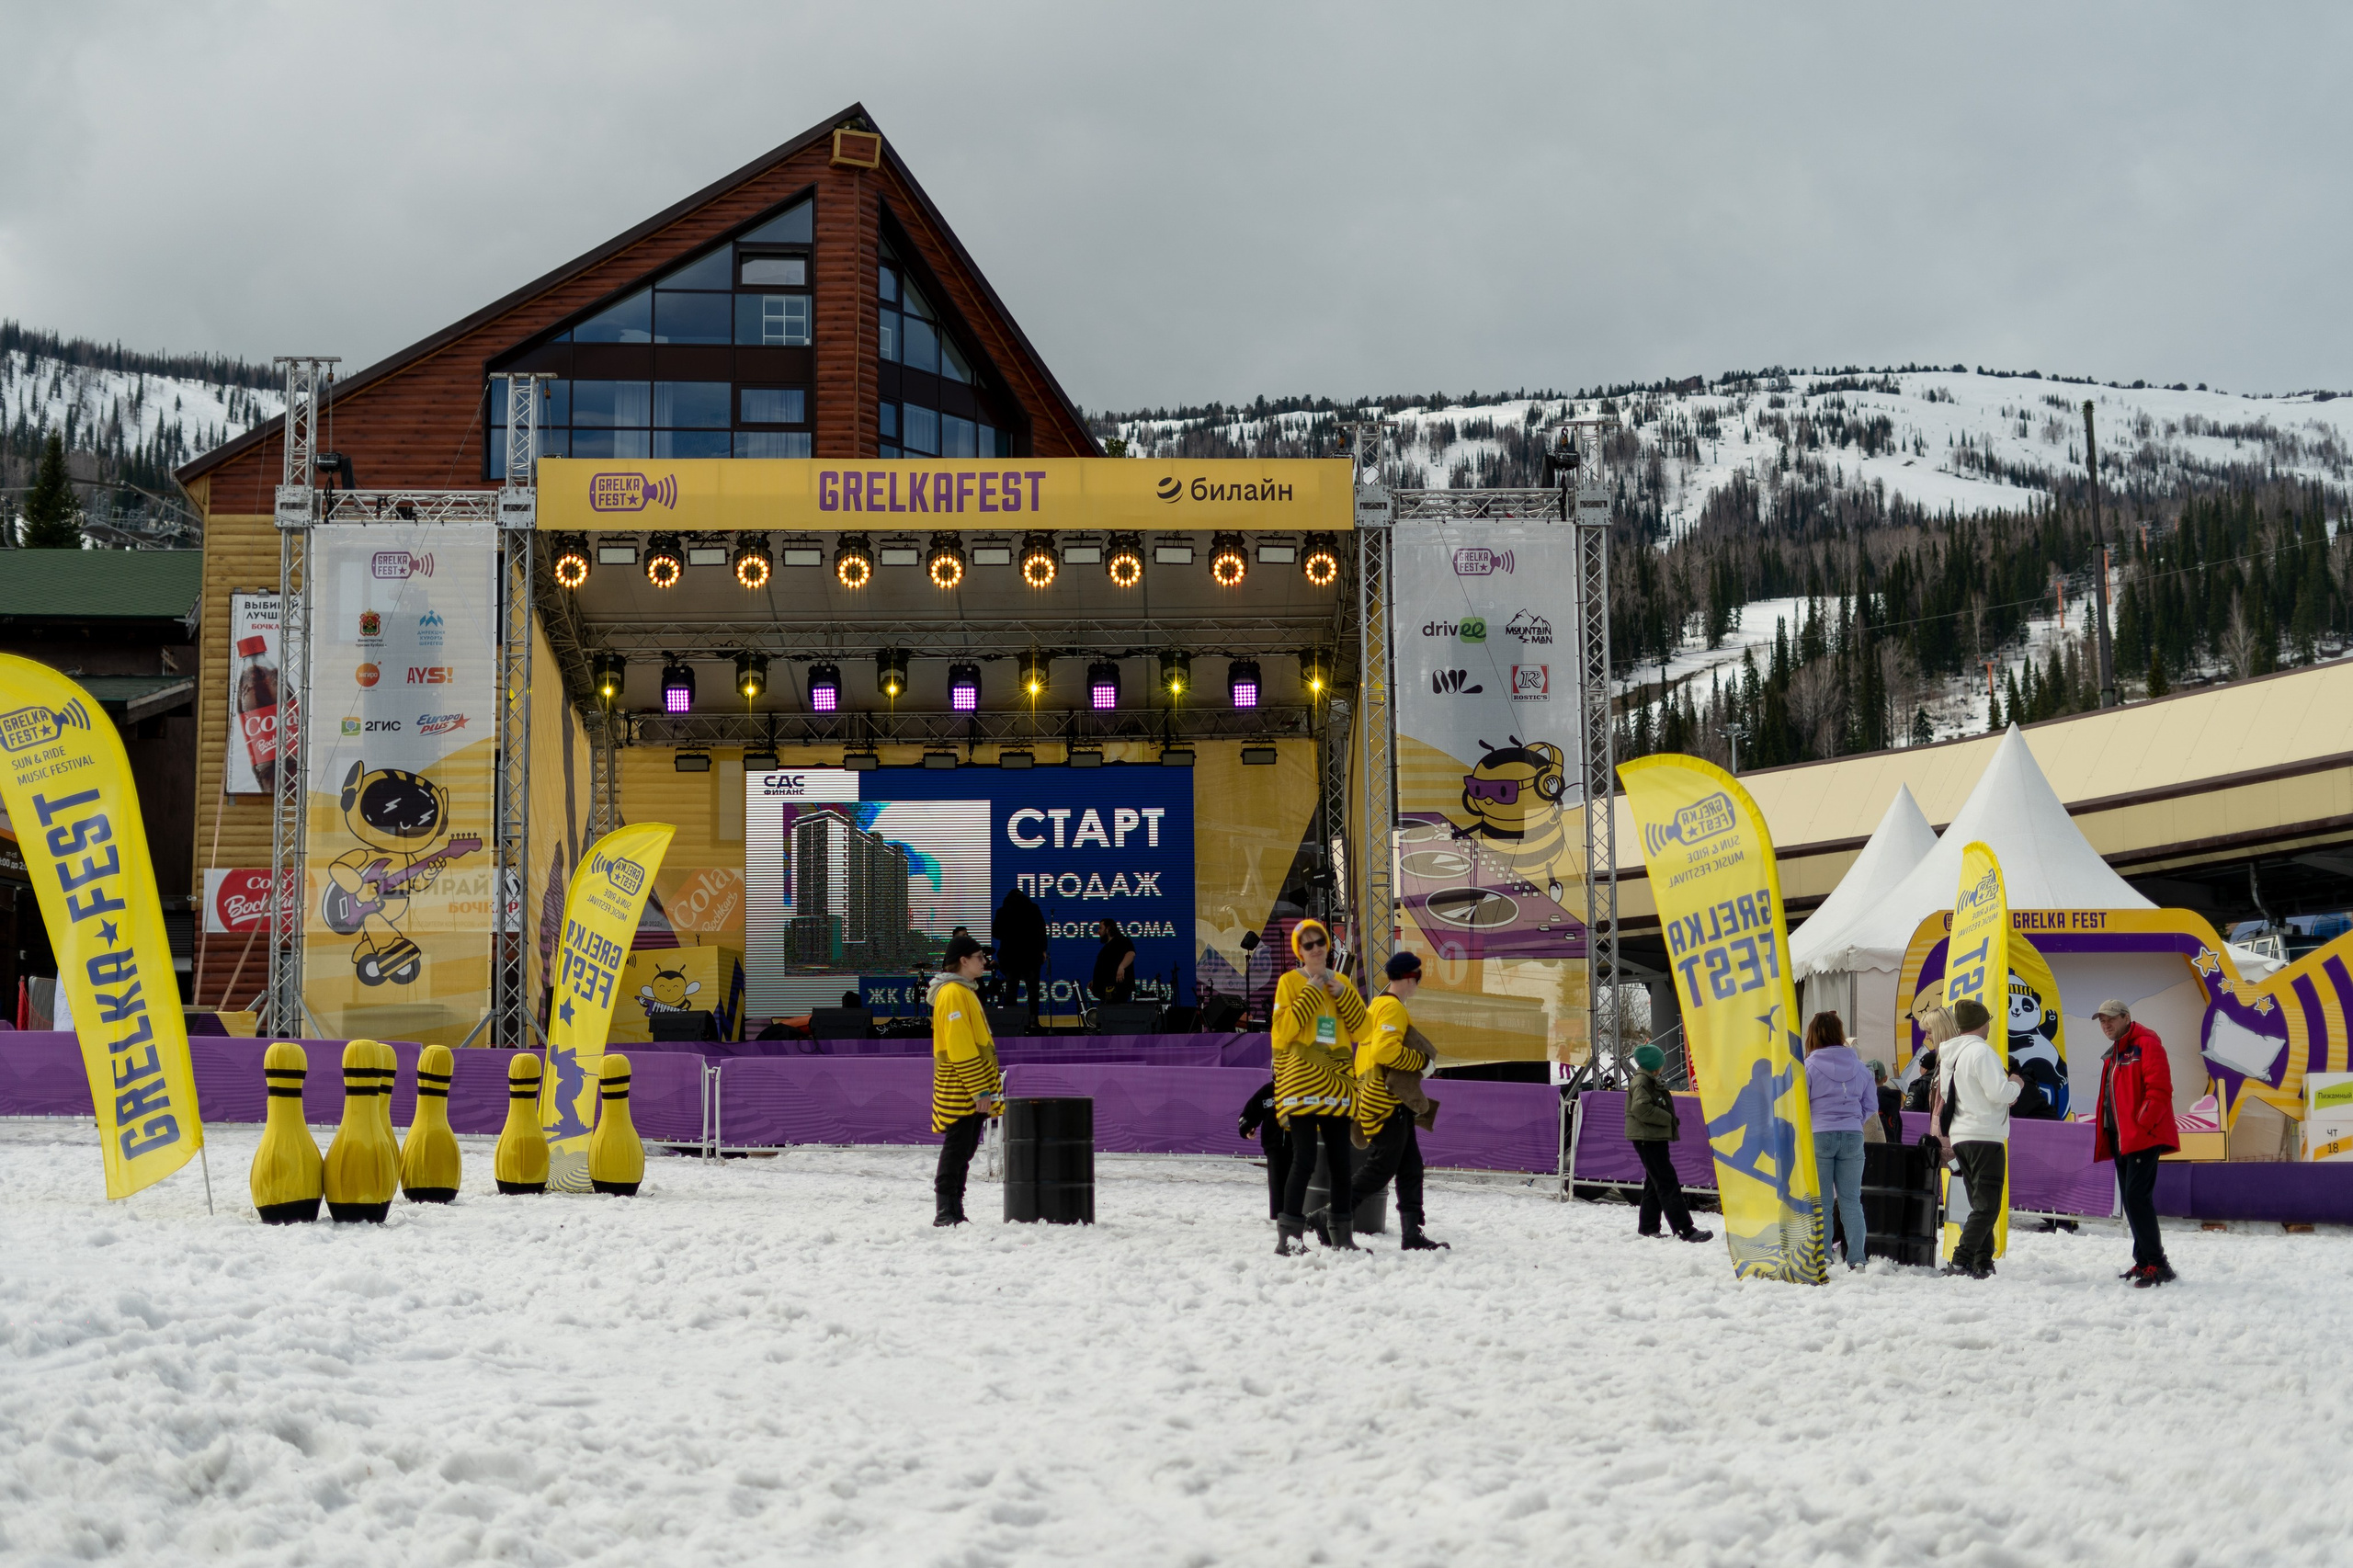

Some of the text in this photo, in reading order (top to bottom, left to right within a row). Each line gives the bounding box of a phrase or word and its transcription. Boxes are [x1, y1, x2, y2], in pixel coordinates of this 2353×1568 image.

[598, 478, 640, 491] GRELKA
[820, 471, 1045, 513] GRELKAFEST
[1190, 475, 1292, 503] билайн
[598, 493, 626, 506] FEST
[378, 555, 407, 565] GRELKA
[1459, 551, 1488, 562] GRELKA
[378, 565, 397, 575] FEST
[1459, 562, 1479, 572] FEST
[1422, 620, 1486, 639] drivee
[1506, 626, 1552, 636] MOUNTAIN
[1531, 636, 1552, 644] MAN
[407, 667, 453, 684] AYS!
[3, 710, 49, 733] GRELKA
[244, 714, 299, 737] Coa
[365, 721, 402, 732] 2ГИС
[7, 727, 39, 746] FEST
[11, 745, 66, 771] SUN & RIDE
[17, 755, 96, 786] MUSIC FESTIVAL
[764, 775, 805, 789] СДС
[1007, 808, 1165, 849] СТАРТ
[246, 876, 287, 889] Coa
[1017, 871, 1163, 900] ПРОДАЖ
[674, 867, 731, 928] Cola
[2013, 912, 2107, 929] GRELKA FEST
[31, 788, 181, 1162] GRELKA FEST
[2327, 1142, 2339, 1153] 18
